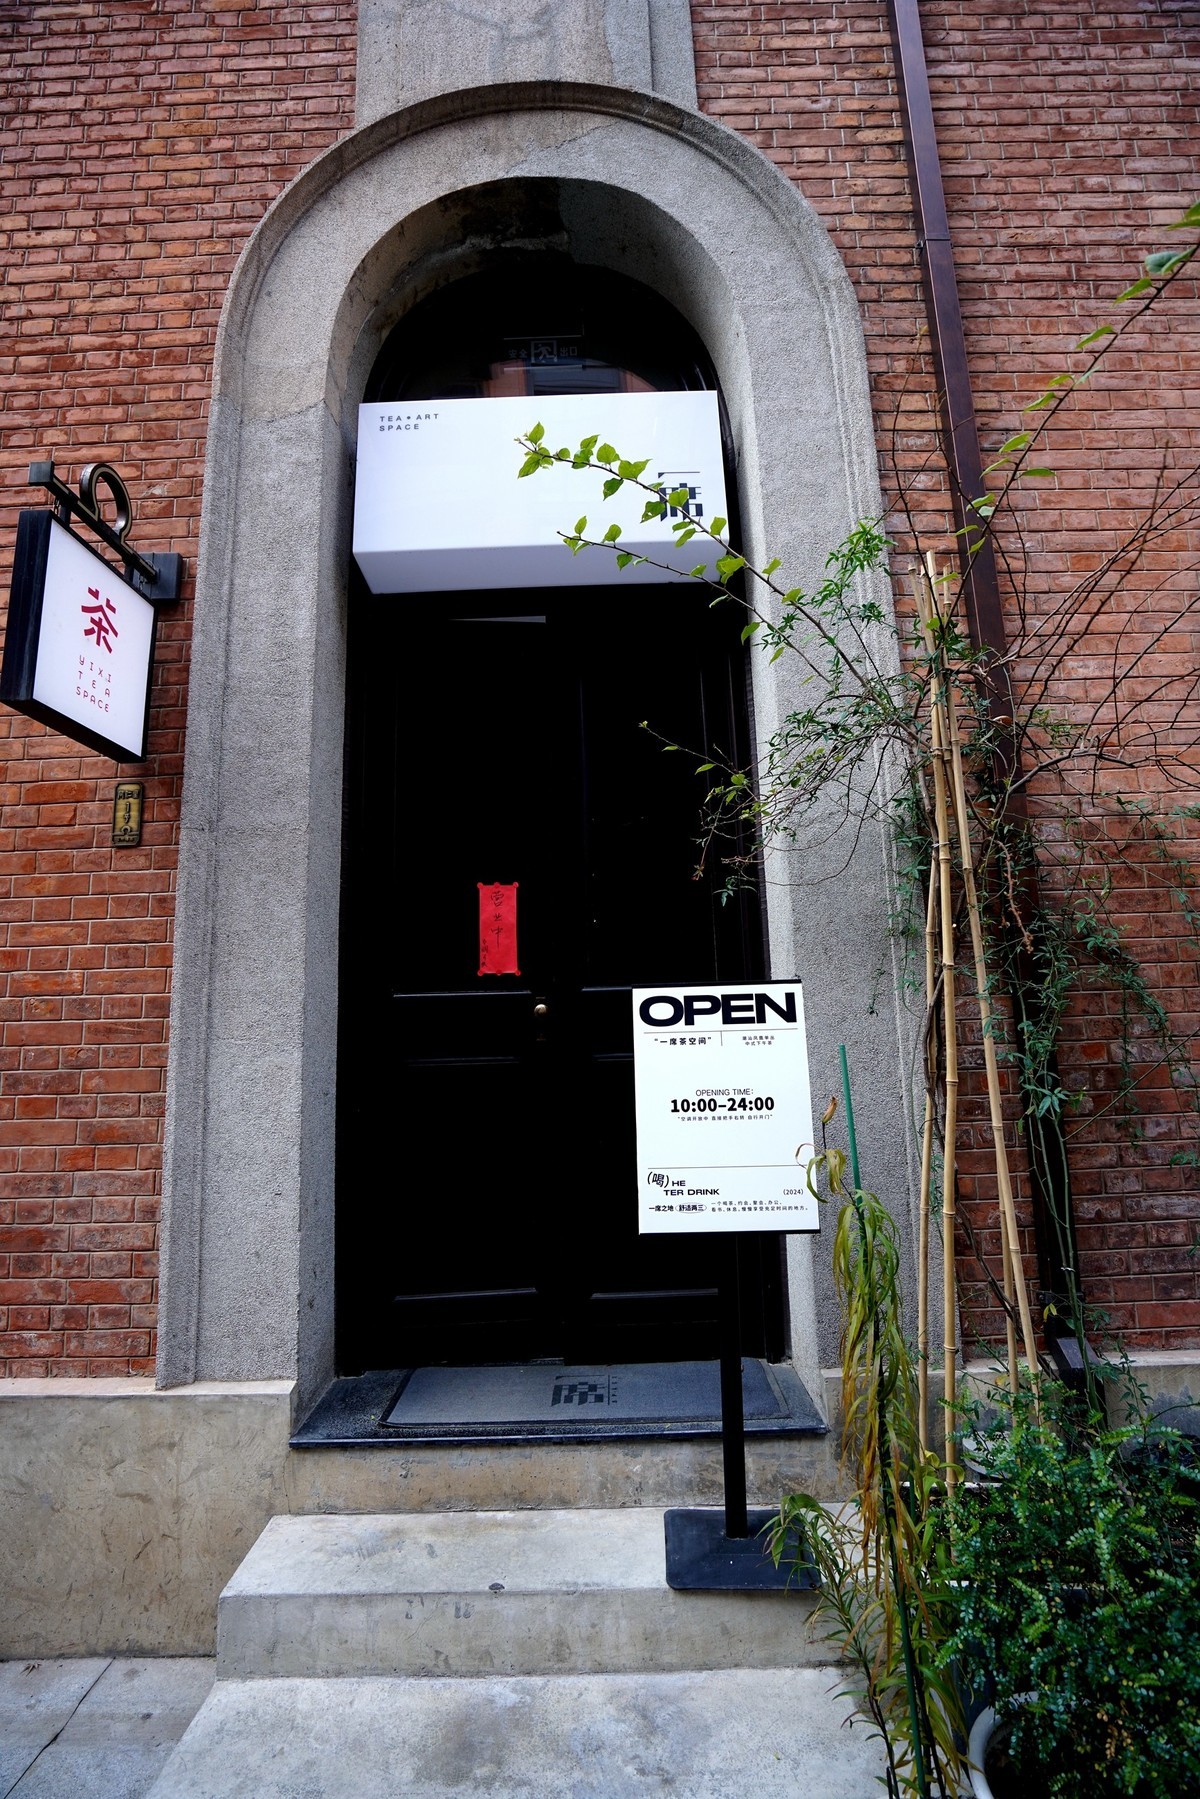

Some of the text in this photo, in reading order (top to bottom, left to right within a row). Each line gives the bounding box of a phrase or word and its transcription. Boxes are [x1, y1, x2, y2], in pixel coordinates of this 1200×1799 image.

[560, 346, 578, 356] 出口
[81, 586, 118, 654] 茶
[79, 655, 112, 683] YIXI
[78, 670, 110, 698] TEA
[76, 686, 109, 712] SPACE
[490, 890, 505, 950] 营业中
[639, 992, 797, 1027] OPEN
[670, 1096, 775, 1113] 10:00-24:00
[732, 1088, 754, 1096] TIME:
[687, 1188, 720, 1196] DRINK
